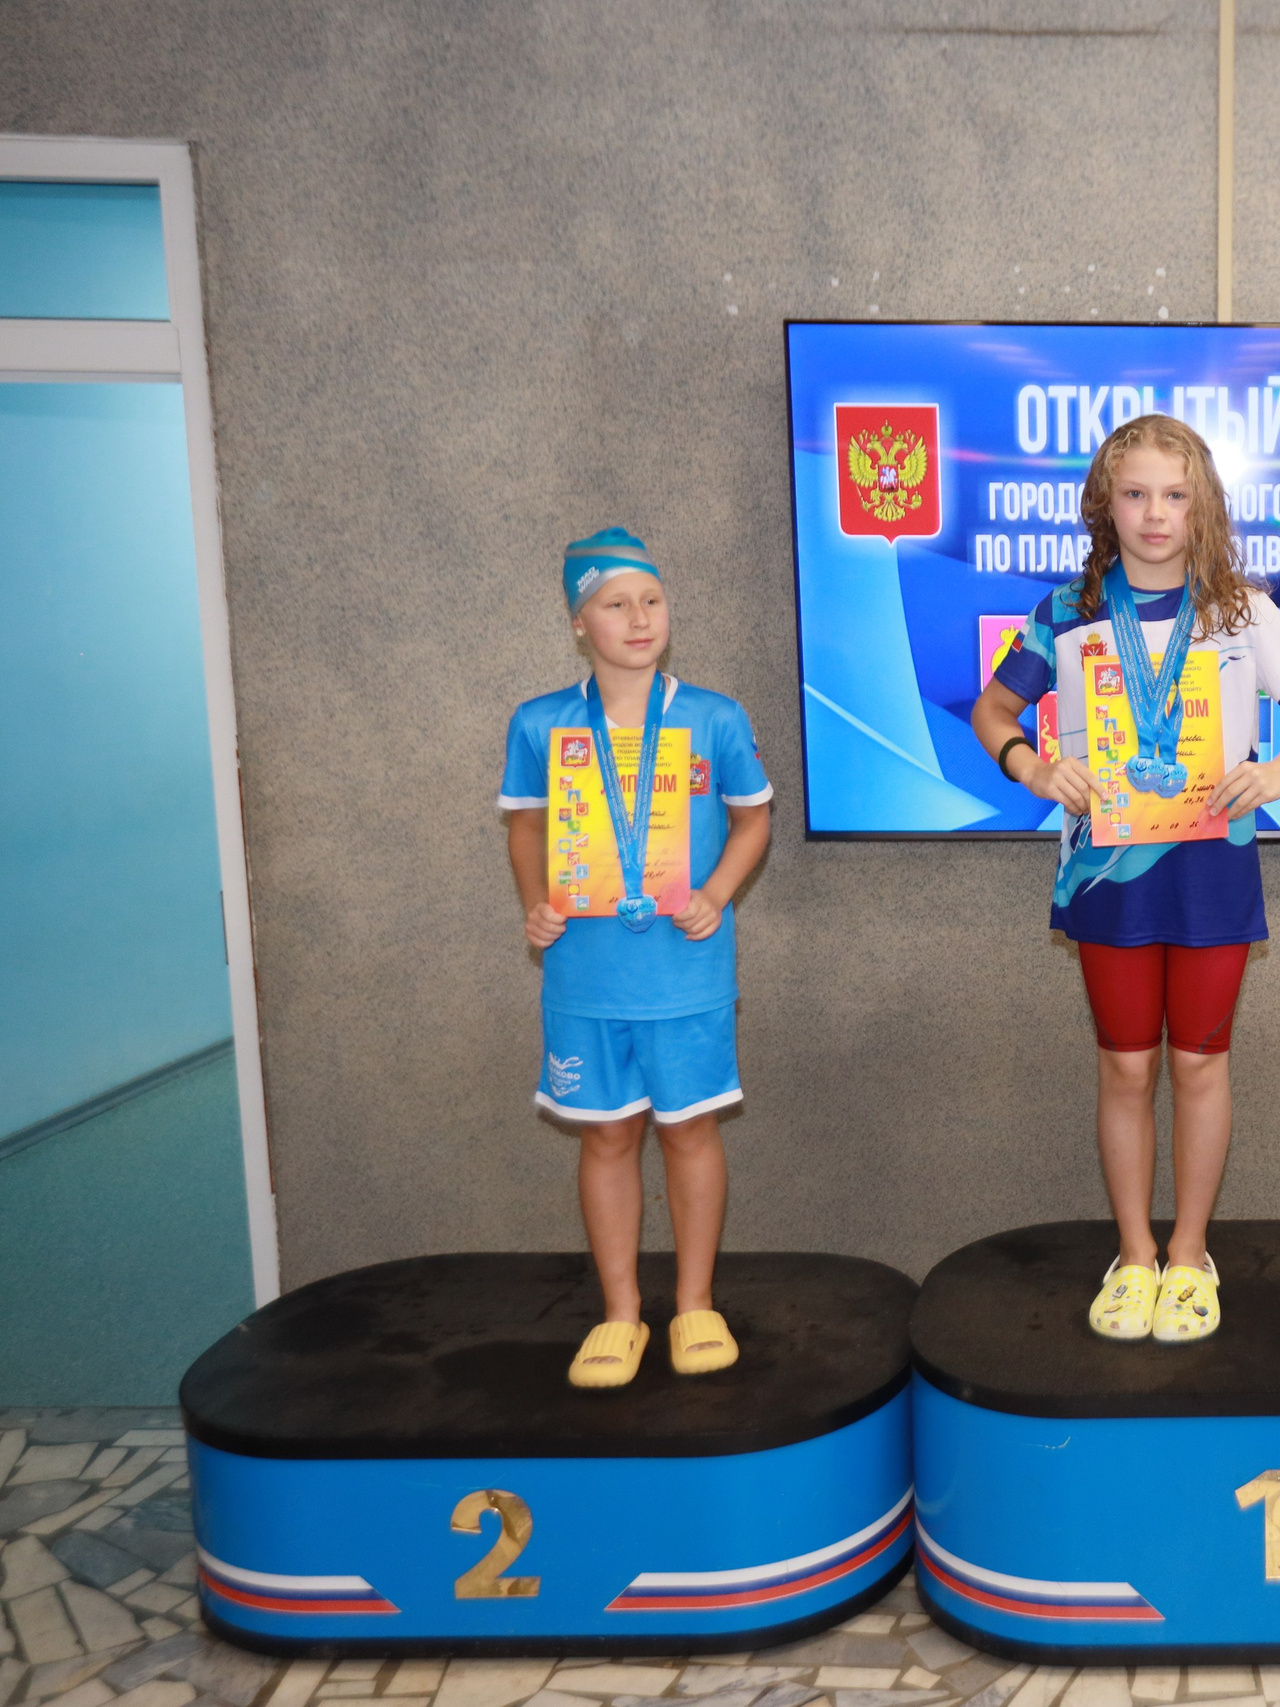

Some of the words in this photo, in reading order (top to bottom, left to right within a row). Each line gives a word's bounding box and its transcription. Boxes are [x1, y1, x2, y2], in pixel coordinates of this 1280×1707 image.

[989, 482, 1084, 524] ГОРОД
[976, 534, 1011, 572] ПО
[601, 774, 677, 794] ИПОМ
[450, 1489, 541, 1600] 2
